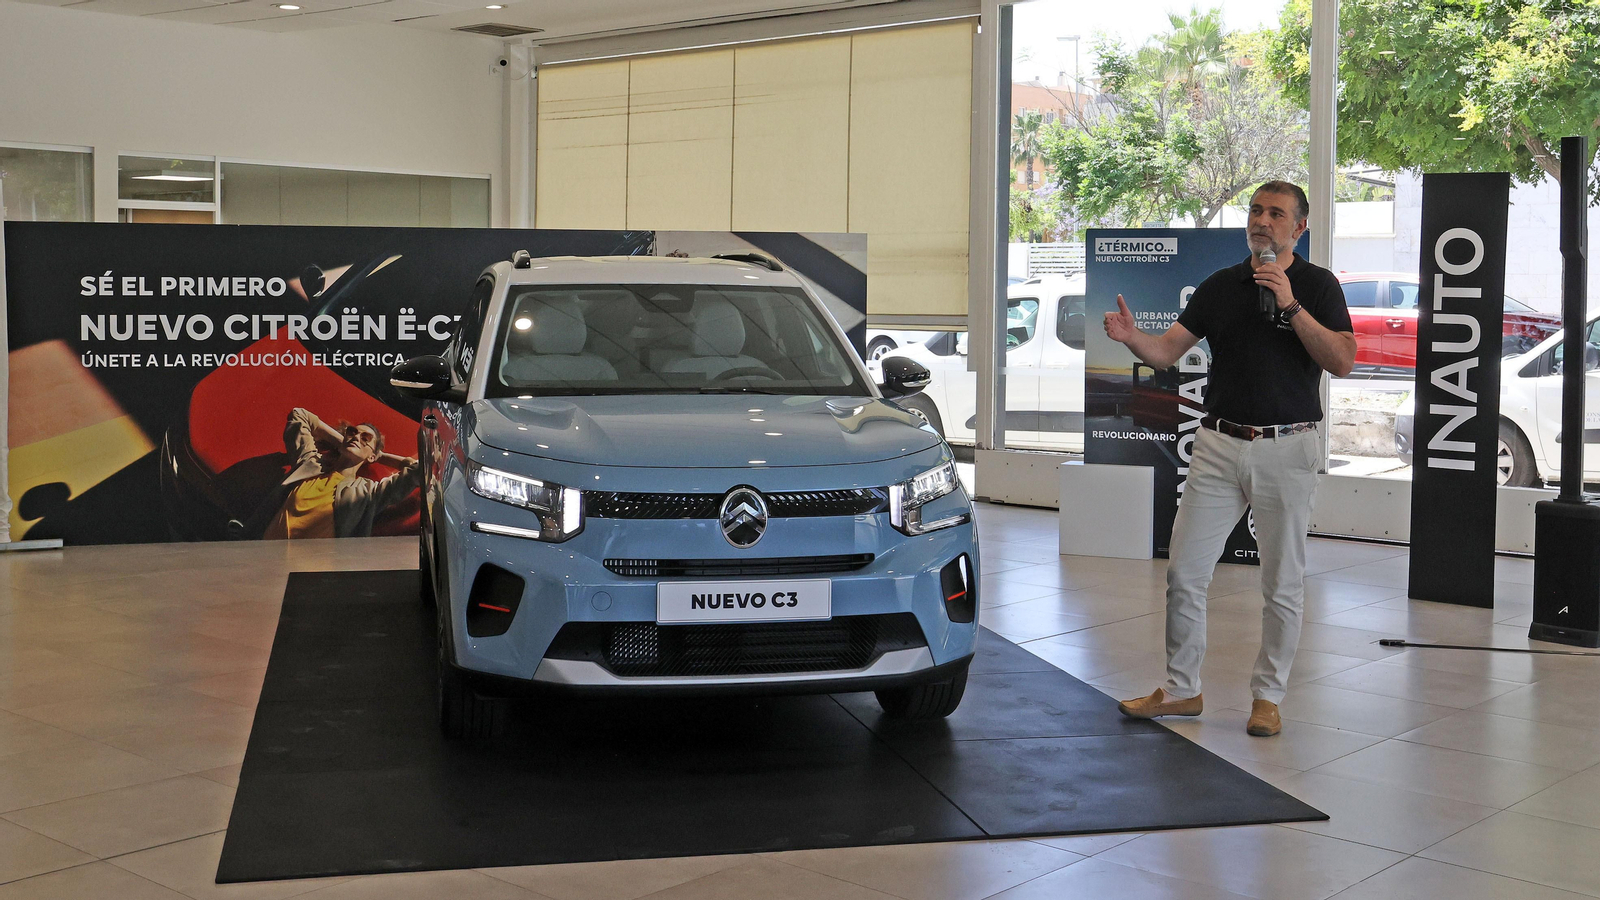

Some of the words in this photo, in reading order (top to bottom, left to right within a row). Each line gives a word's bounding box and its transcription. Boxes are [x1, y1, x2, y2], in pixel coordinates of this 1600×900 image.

[1098, 239, 1174, 252] ¿TÉRMICO...
[1123, 254, 1158, 263] CITROËN
[80, 270, 114, 297] SÉ
[121, 276, 154, 297] EL
[161, 276, 287, 297] PRIMERO
[1135, 311, 1179, 320] URBANO
[80, 314, 214, 341] NUEVO
[223, 306, 386, 341] CITROËN
[1427, 227, 1485, 471] INAUTO
[81, 350, 141, 368] ÚNETE
[146, 353, 159, 367] A
[164, 353, 186, 367] LA
[191, 350, 307, 367] REVOLUCIÓN
[312, 350, 406, 367] ELÉCTRICA
[1092, 430, 1177, 442] REVOLUCIONARIO
[1234, 549, 1260, 558] CIT
[691, 592, 766, 610] NUEVO
[771, 591, 798, 608] C3
